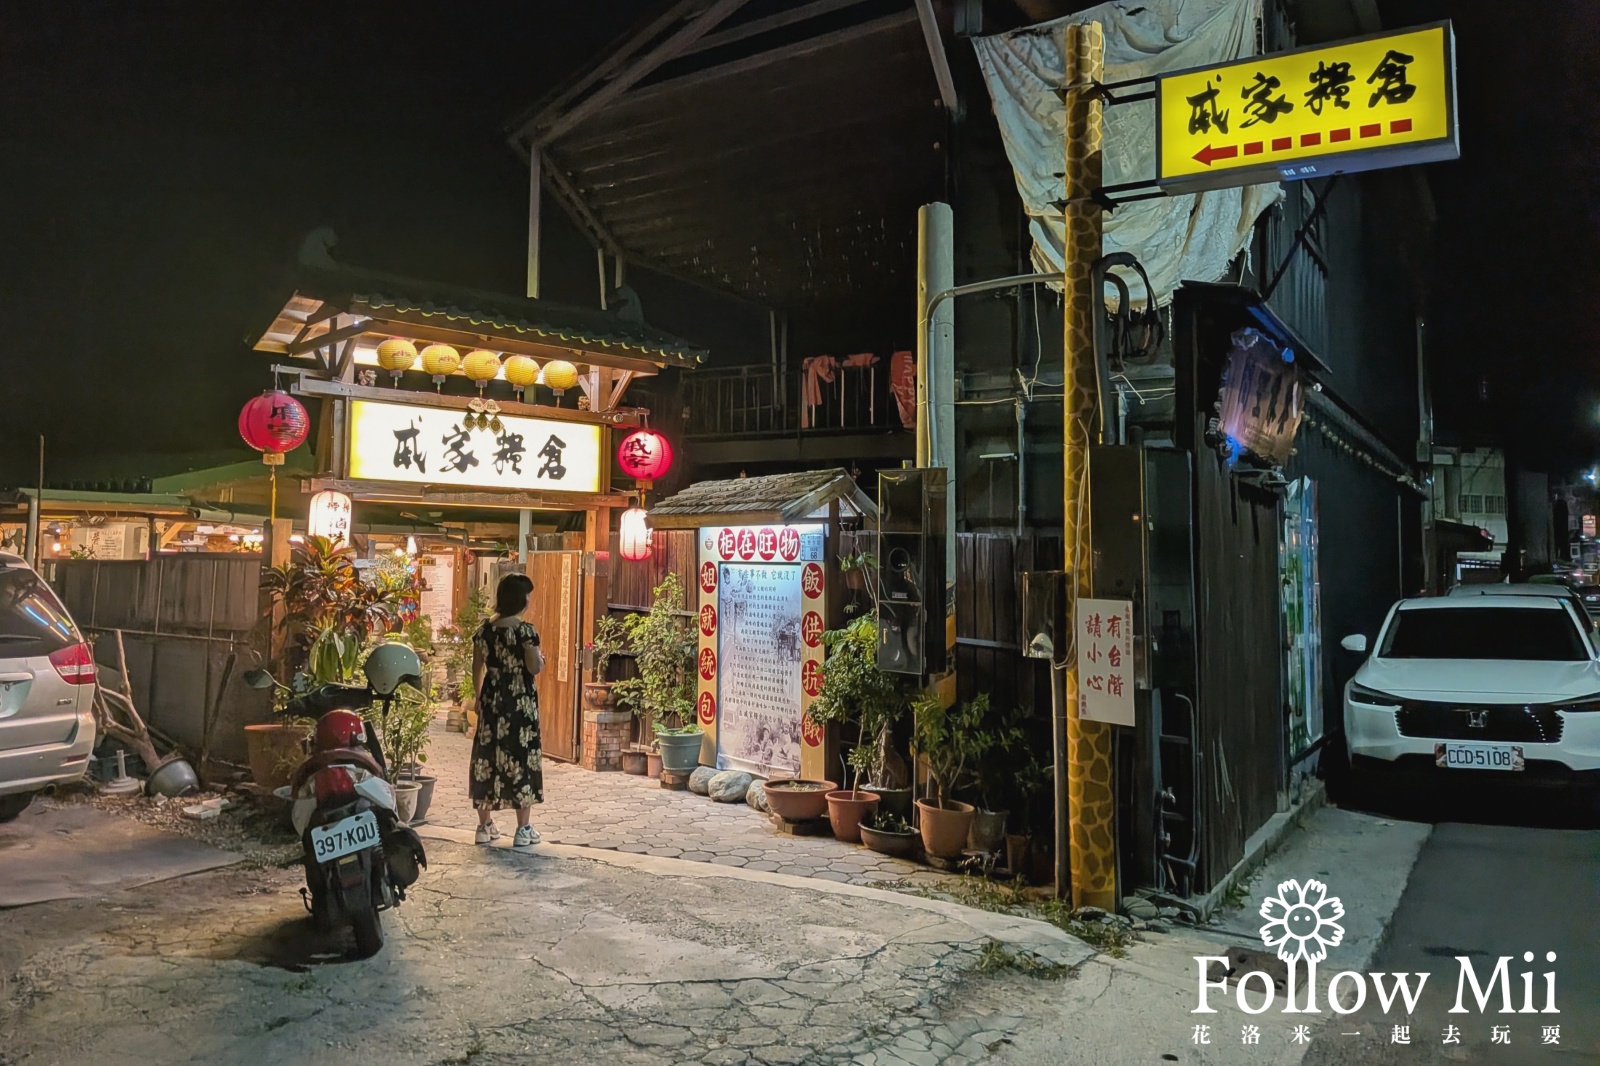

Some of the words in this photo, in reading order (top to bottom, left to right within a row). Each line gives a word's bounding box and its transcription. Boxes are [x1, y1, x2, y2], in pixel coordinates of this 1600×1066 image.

[1085, 613, 1103, 690] 請小心
[1107, 615, 1124, 697] 有台階
